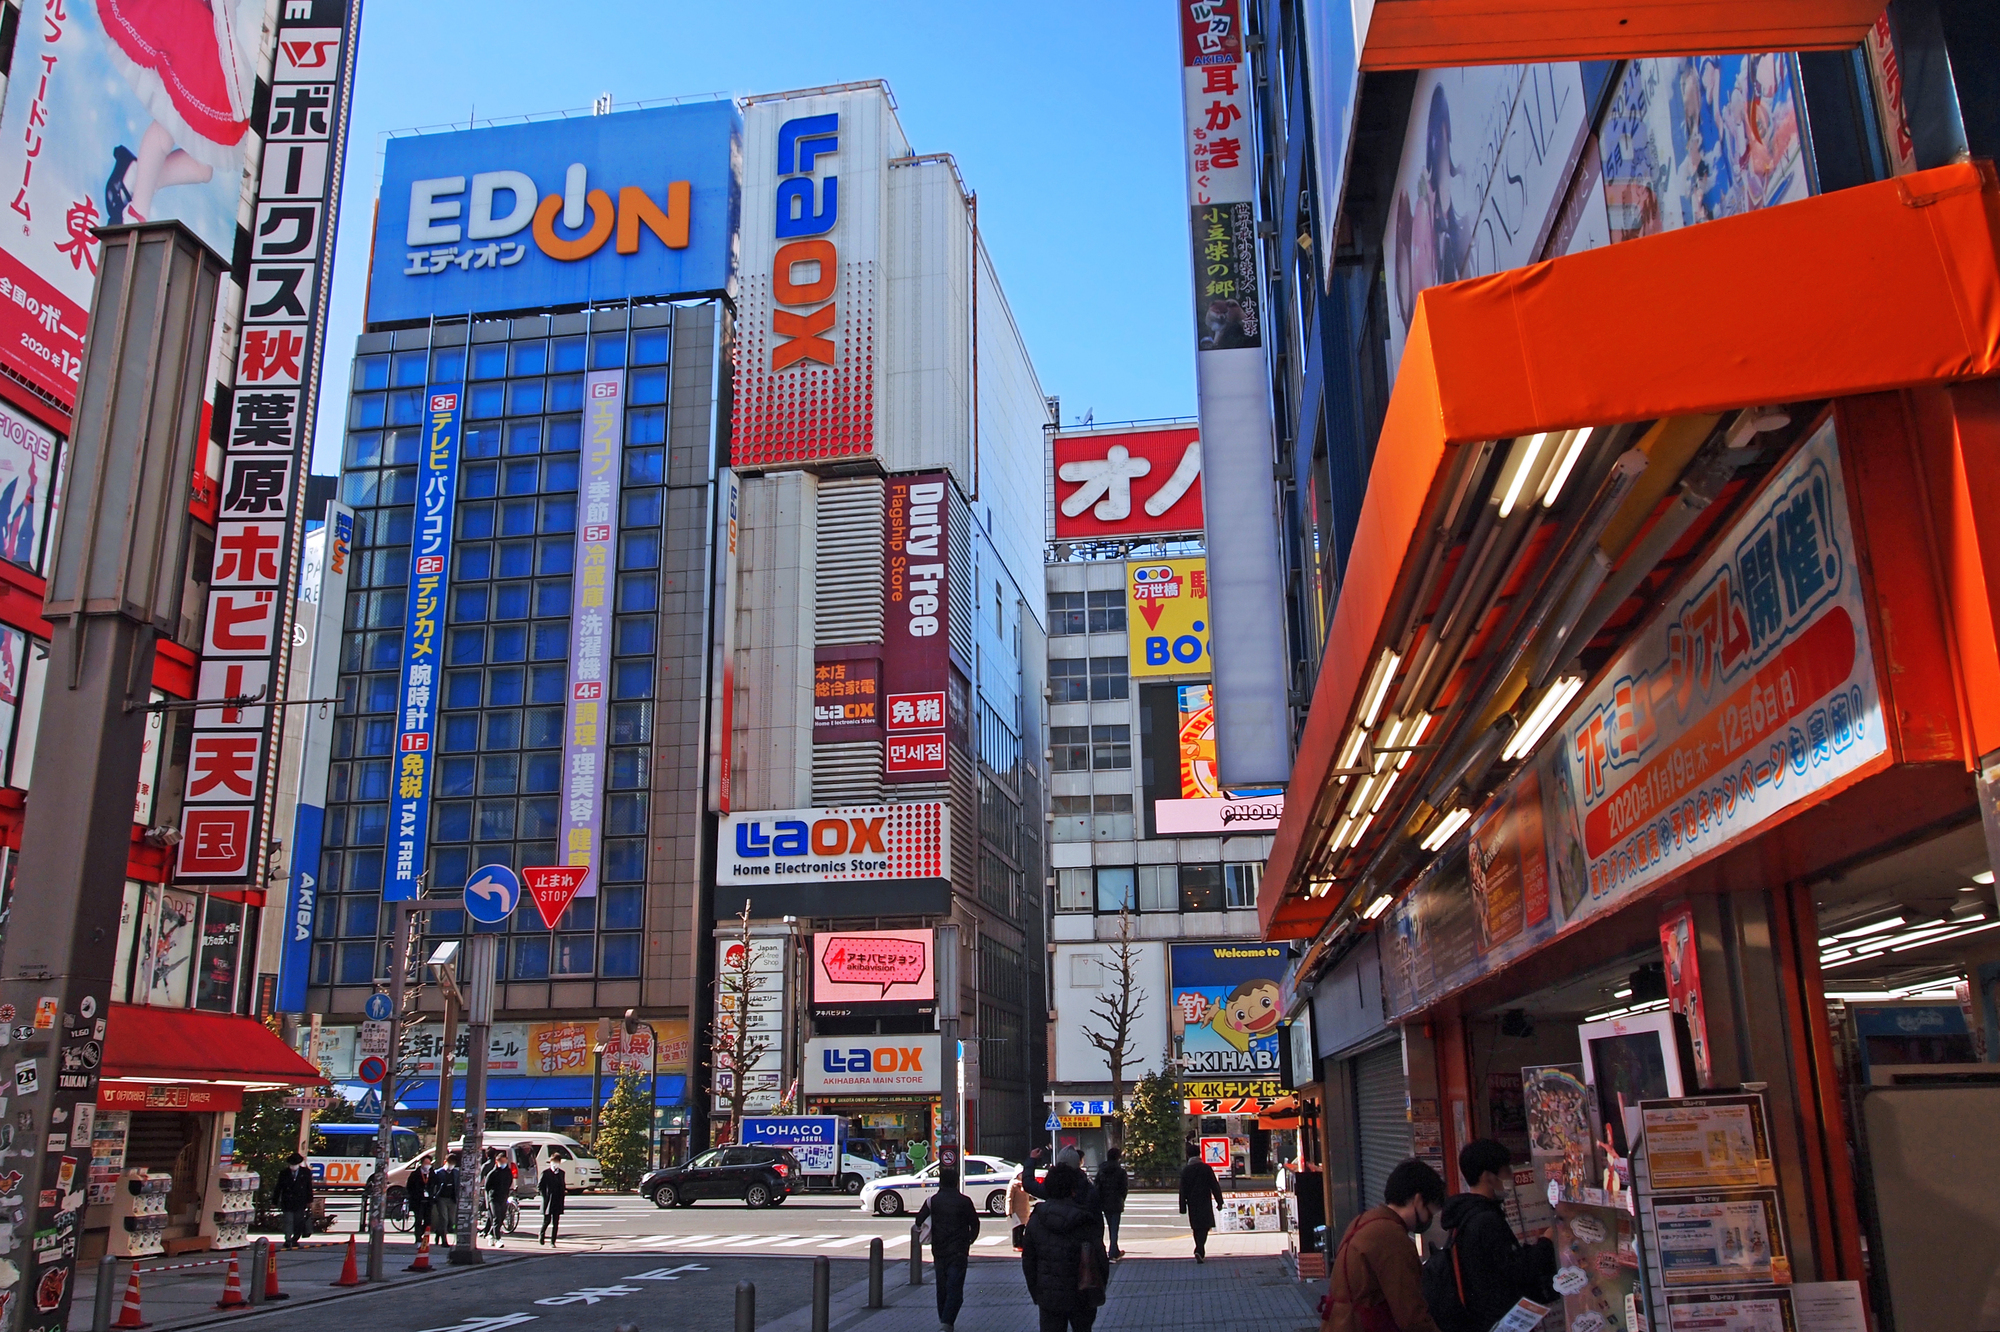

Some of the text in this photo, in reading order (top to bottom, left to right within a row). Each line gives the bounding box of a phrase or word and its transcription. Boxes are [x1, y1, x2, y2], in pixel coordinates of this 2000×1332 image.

[1193, 54, 1234, 65] AKIBA
[1202, 64, 1241, 168] 耳かき
[1193, 127, 1211, 204] もみほぐし
[406, 163, 691, 261] EDION
[404, 242, 526, 276] エディオン
[1202, 207, 1235, 298] 小豆柴の郷
[594, 384, 616, 397] 6F
[433, 397, 455, 410] 3F
[586, 400, 614, 524] エアコン・季節
[421, 412, 453, 554] テレビ・パソコン
[586, 527, 609, 541] 5F
[889, 484, 907, 602] Flagship Store
[419, 558, 443, 572] 2F
[906, 482, 944, 637] Duty Free
[1134, 584, 1180, 599] 万世橋
[577, 544, 609, 681] 冷蔵庫・洗濯機
[405, 575, 439, 730] デジカメ・腕時計
[1146, 634, 1212, 667] BO
[815, 664, 846, 681] 本店
[576, 683, 600, 698] 4F
[815, 678, 876, 698] 総合家電
[891, 698, 941, 724] 免税
[405, 735, 426, 749] 1F
[890, 743, 942, 763] 면세점
[399, 753, 425, 798] 免税
[396, 801, 417, 881] TAX FREE
[733, 857, 887, 876] Home Electronics Store
[535, 873, 574, 887] 止まれ
[540, 891, 568, 902] STOP
[295, 872, 315, 941] AKIBA
[847, 953, 917, 965] アキバビジョン
[1213, 947, 1280, 959] Welcome to
[847, 964, 895, 972] akibavision
[60, 1075, 88, 1087] TAIKAN
[823, 1077, 870, 1085] AKIHABARA
[896, 1076, 923, 1084] STORE
[1201, 1083, 1221, 1097] 4K
[756, 1124, 823, 1136] LOHACO
[1709, 1293, 1736, 1301] Blu-ray
